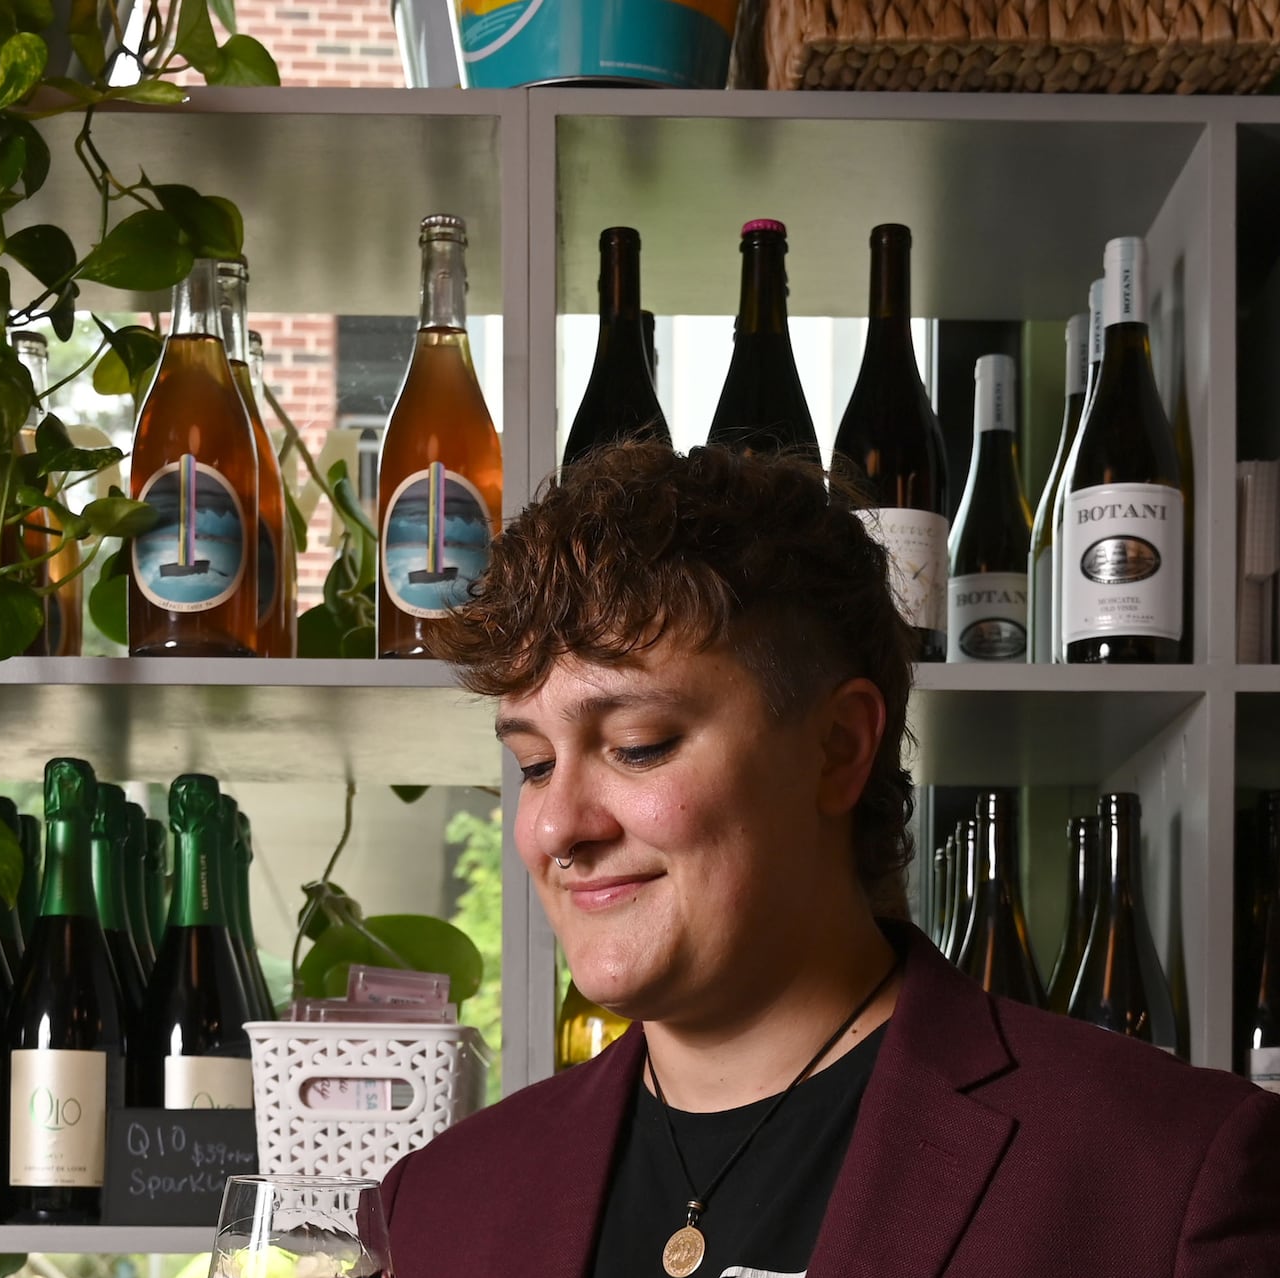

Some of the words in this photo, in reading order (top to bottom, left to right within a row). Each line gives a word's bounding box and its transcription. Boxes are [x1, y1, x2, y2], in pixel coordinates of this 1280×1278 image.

[1122, 268, 1131, 314] BOTANI
[1077, 503, 1168, 525] BOTANI
[955, 588, 1028, 608] BOTAN
[199, 854, 208, 870] LIFE
[199, 871, 209, 910] CELEBRATE
[127, 1122, 187, 1160] Q10
